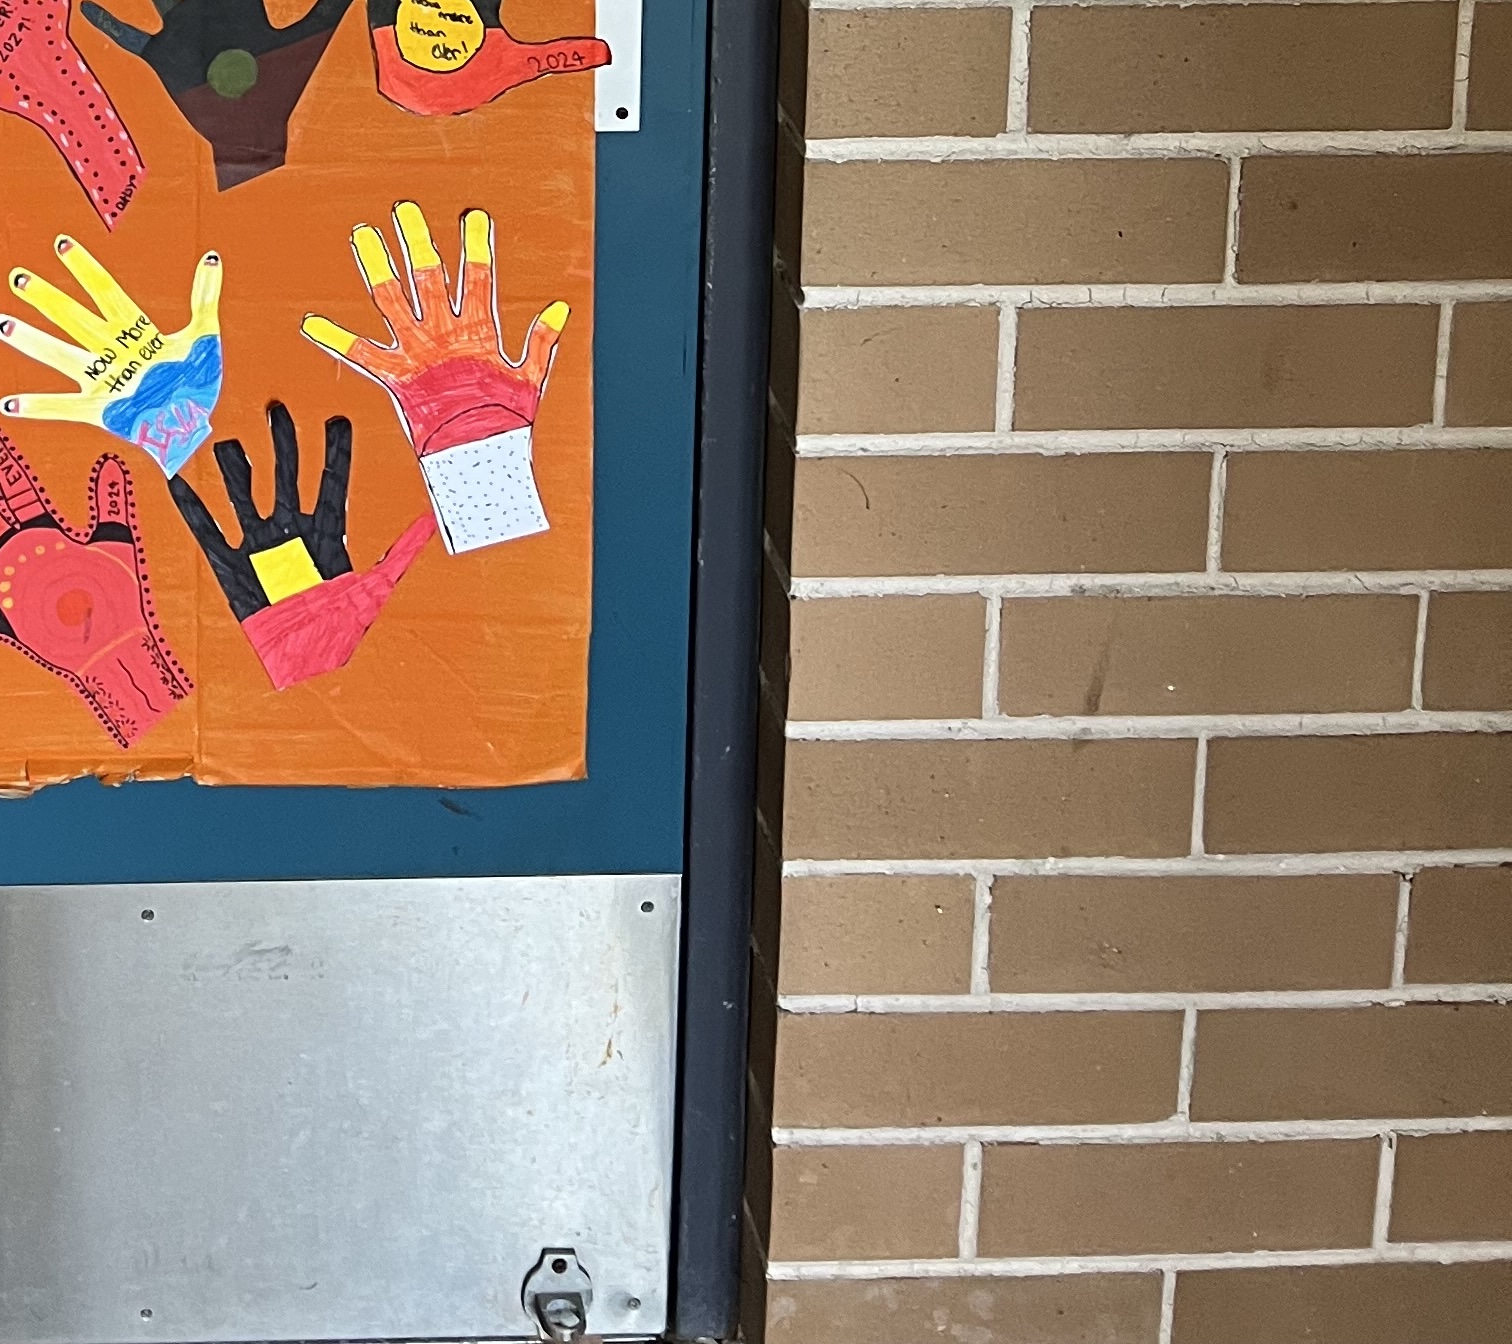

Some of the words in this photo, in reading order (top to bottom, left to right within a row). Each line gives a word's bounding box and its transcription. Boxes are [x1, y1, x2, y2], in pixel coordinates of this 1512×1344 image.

[527, 50, 586, 73] 2024
[116, 314, 152, 349] More
[104, 360, 142, 394] than
[139, 332, 166, 362] ever
[107, 480, 122, 516] 2024
